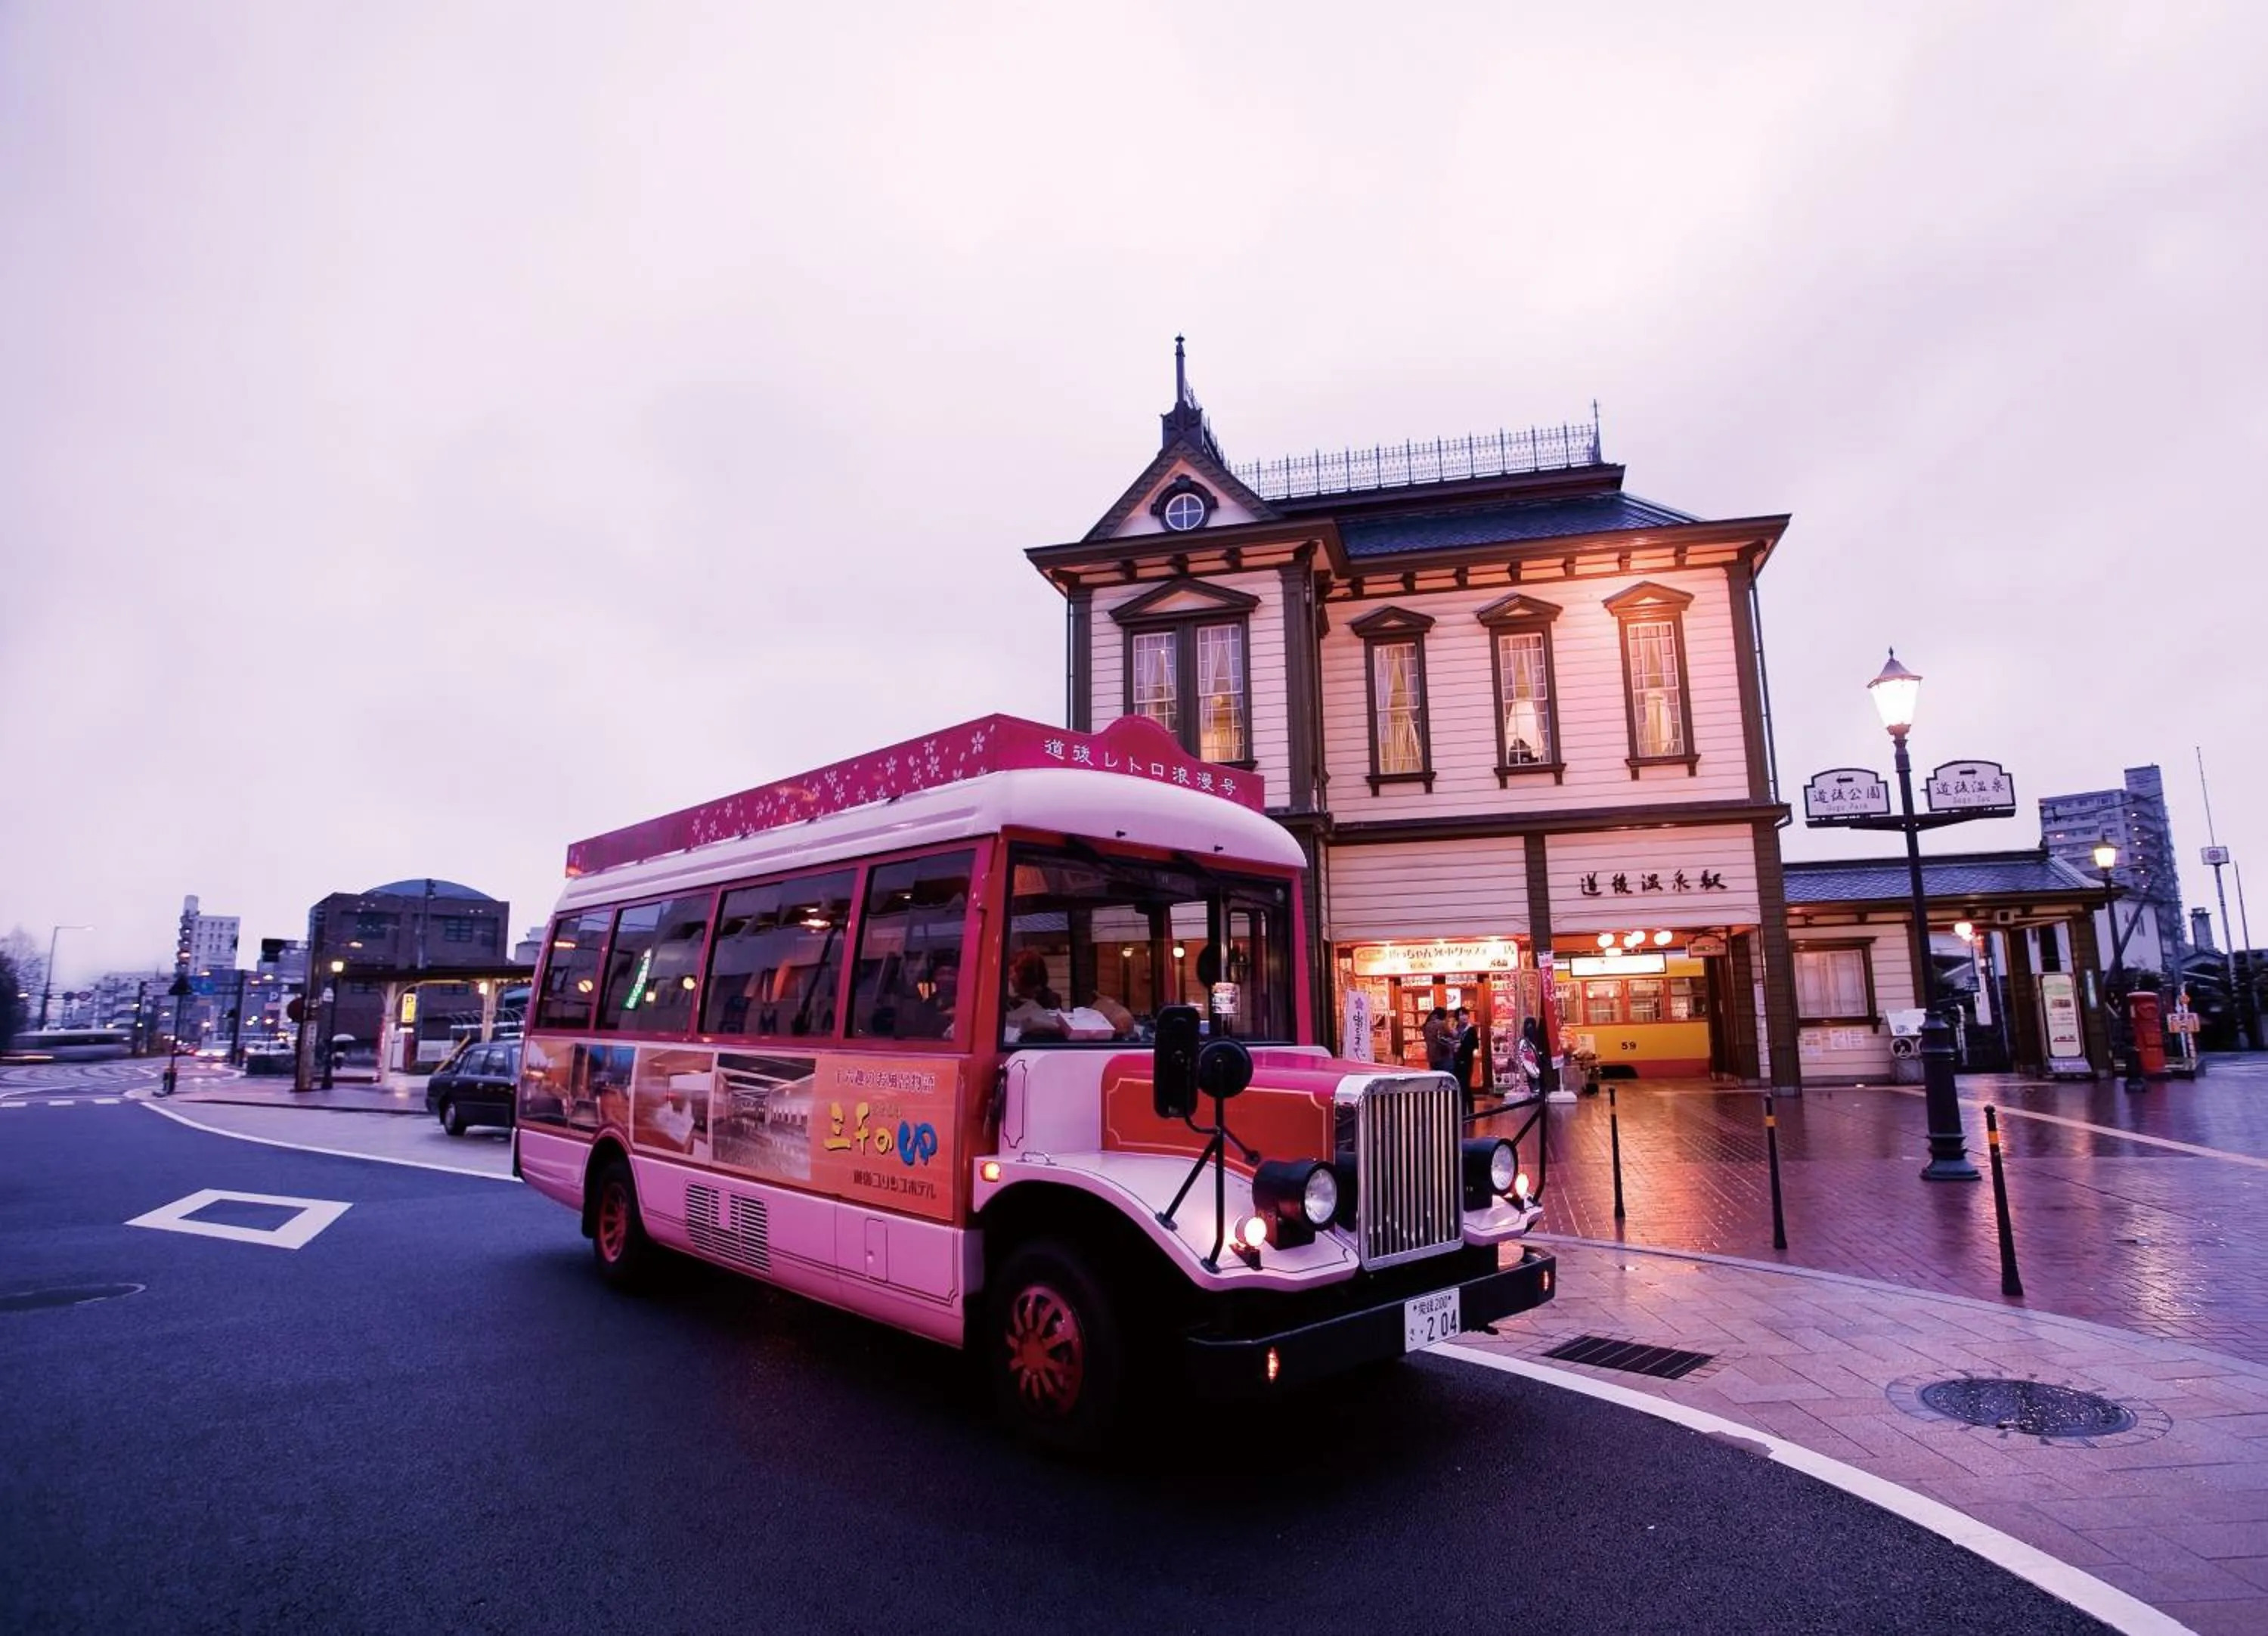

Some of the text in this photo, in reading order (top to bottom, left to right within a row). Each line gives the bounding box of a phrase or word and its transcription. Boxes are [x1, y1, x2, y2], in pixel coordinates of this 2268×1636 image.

[1043, 738, 1236, 796] 道後レトロ浪漫号
[1814, 785, 1880, 804] 道後公園
[1935, 776, 2005, 796] 道後温泉
[1580, 869, 1727, 897] 道後温泉駅
